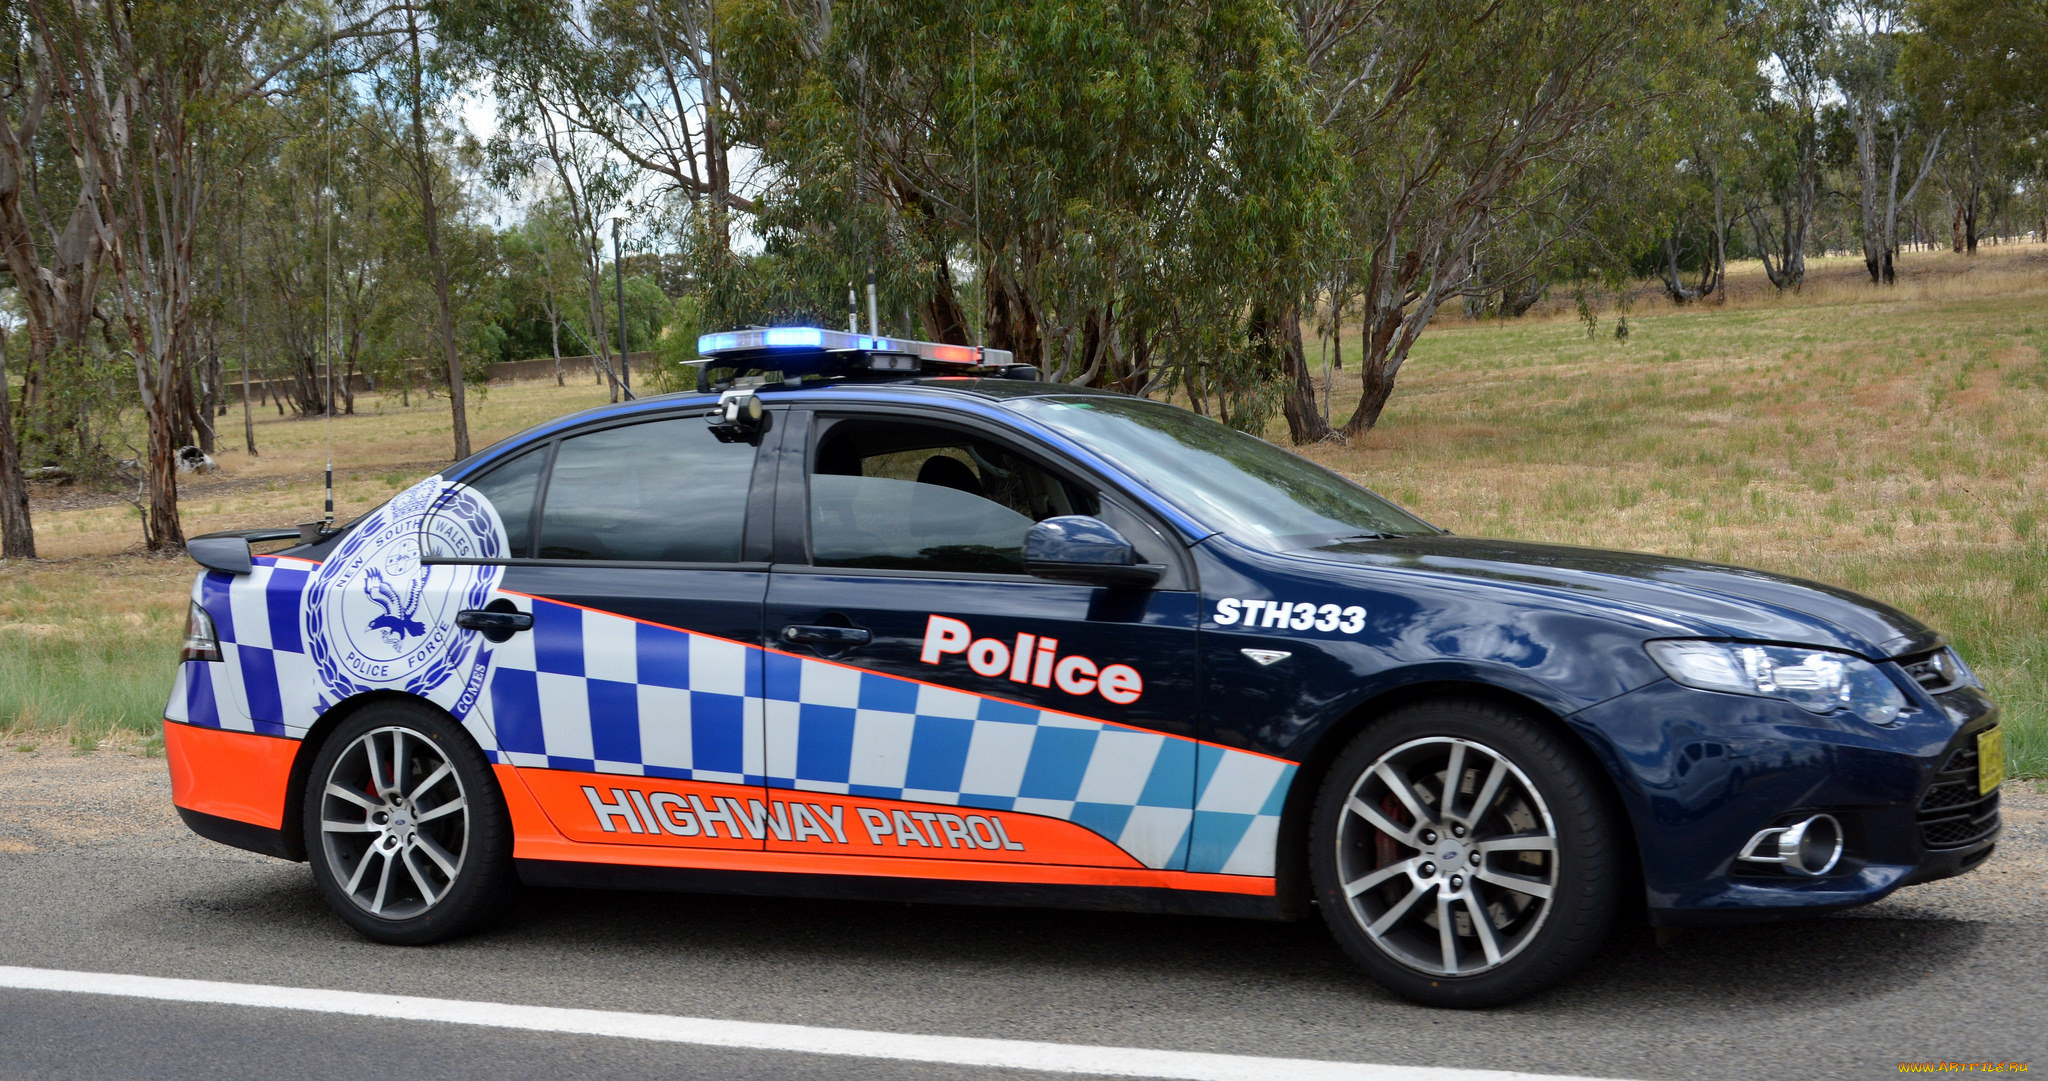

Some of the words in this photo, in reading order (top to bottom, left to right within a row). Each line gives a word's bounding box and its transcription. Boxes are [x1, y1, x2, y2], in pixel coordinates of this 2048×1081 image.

[336, 556, 364, 588] NEW
[376, 518, 423, 547] SOUTH
[435, 520, 470, 557] WALES
[1213, 597, 1367, 634] STH333
[346, 652, 389, 677] POLICE
[408, 620, 450, 668] FORCE
[920, 614, 1143, 704] Police
[457, 663, 486, 714] COMES
[580, 785, 849, 844] HIGHWAY
[856, 807, 1025, 851] PATROL
